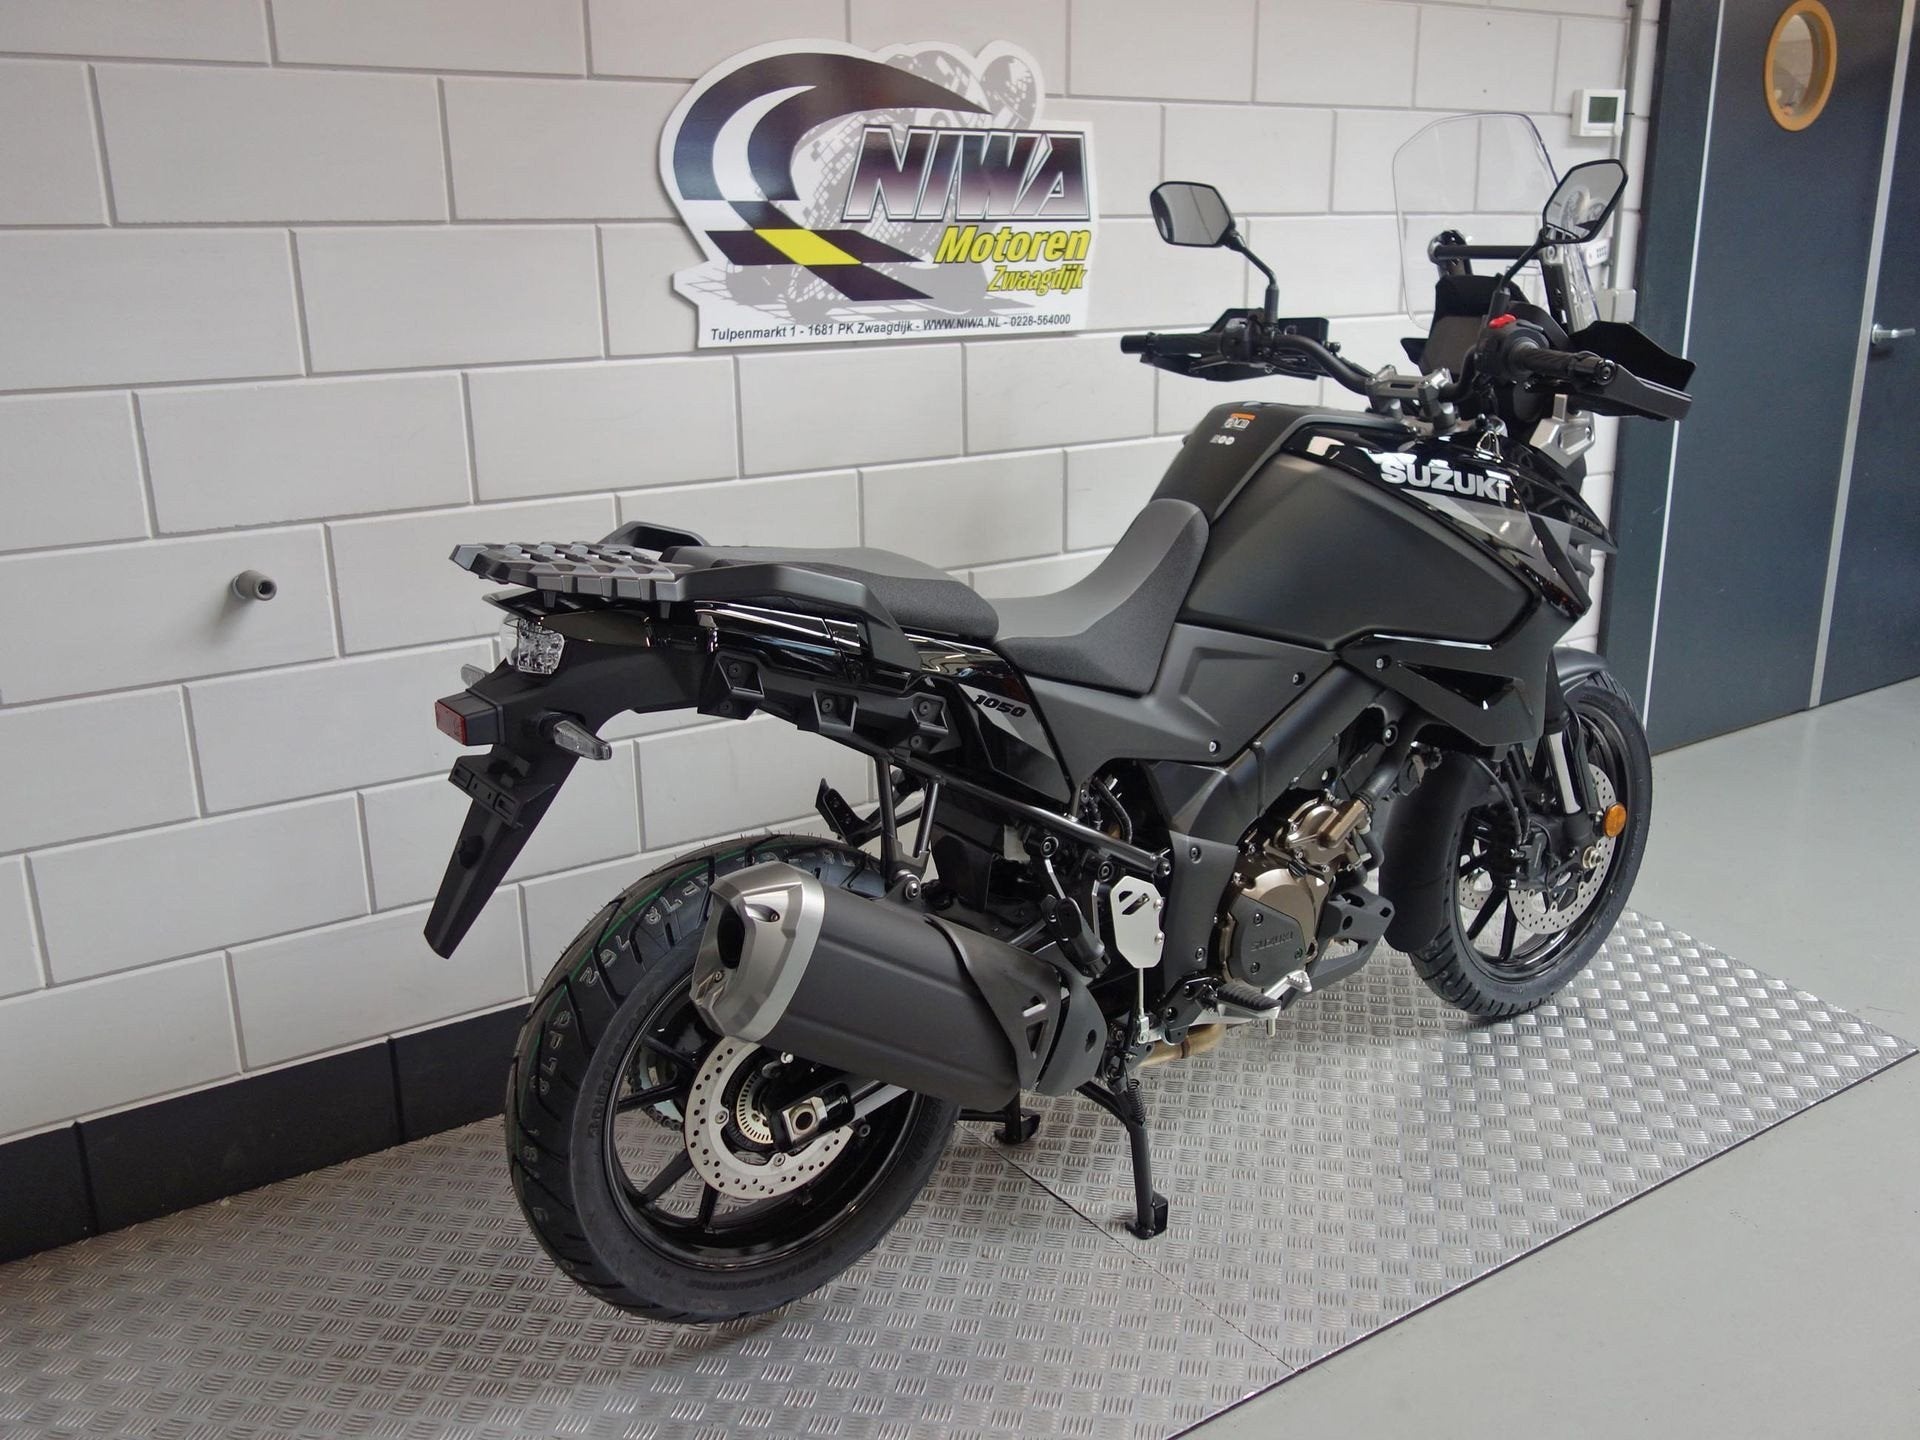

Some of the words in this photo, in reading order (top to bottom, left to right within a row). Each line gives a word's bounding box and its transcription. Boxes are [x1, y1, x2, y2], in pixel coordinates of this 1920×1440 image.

[841, 124, 1091, 223] NIWA
[933, 225, 1092, 264] Motoren
[986, 264, 1087, 296] Zwaagdijk
[711, 325, 787, 342] Tulpenmarkt
[790, 325, 796, 337] 1
[808, 323, 834, 336] 1681
[838, 322, 855, 335] PK
[857, 321, 913, 335] Zwaagdijk
[923, 315, 1001, 331] WWW.NIWA.NL
[1010, 313, 1071, 327] 0228-564000
[1380, 459, 1507, 502] SUZUKI
[975, 694, 1027, 718] 1050
